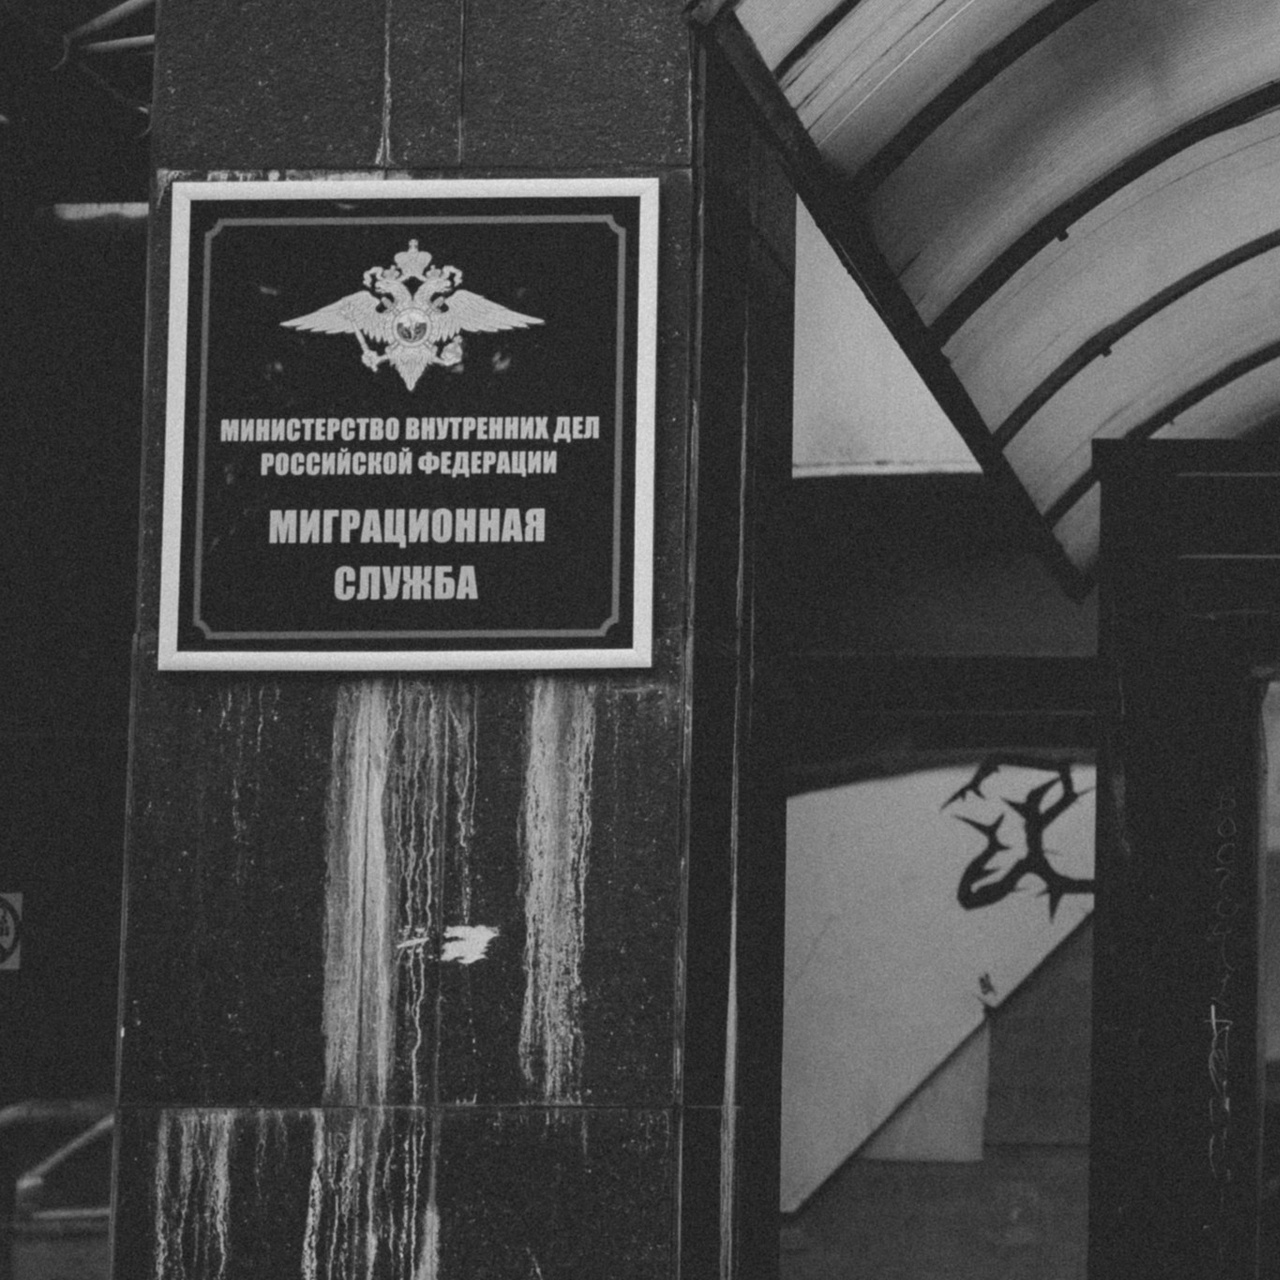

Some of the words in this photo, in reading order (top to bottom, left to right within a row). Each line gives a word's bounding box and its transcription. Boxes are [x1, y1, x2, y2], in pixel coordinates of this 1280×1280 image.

[220, 417, 400, 442] МИНИСТЕРСТВО
[405, 416, 549, 441] ВНУТРЕННИХ
[553, 416, 600, 443] ДЕЛ
[260, 447, 413, 476] РОССИЙСКОЙ
[417, 450, 558, 478] ФЕДЕРАЦИИ
[269, 507, 546, 549] МИГРАЦИОННАЯ
[334, 565, 479, 601] СЛУЖБА
